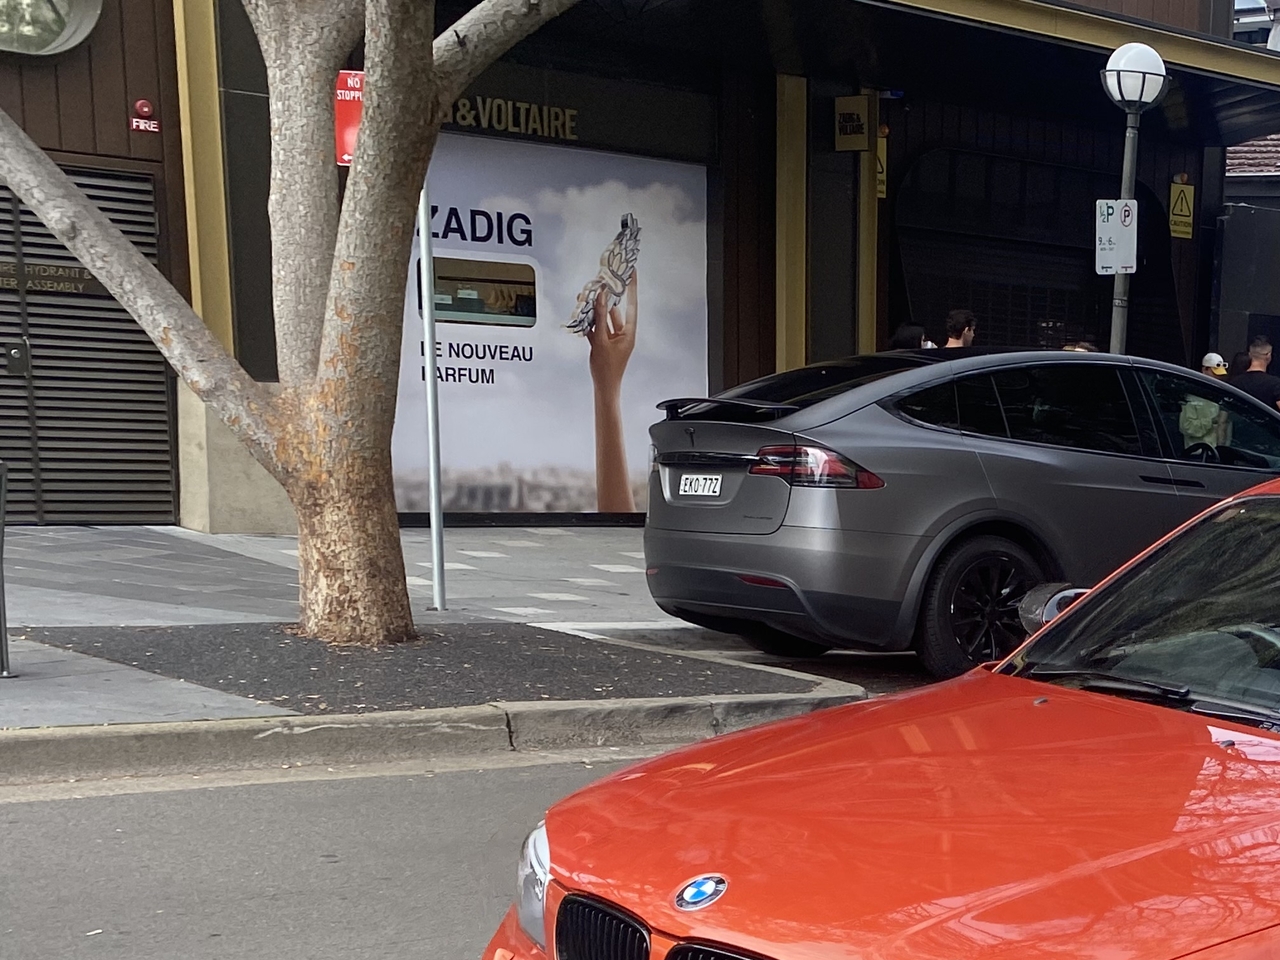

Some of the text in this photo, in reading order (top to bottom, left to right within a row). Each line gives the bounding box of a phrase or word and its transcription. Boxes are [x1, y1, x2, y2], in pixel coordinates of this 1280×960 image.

[347, 77, 361, 88] NO
[336, 89, 363, 101] STOPPI
[443, 96, 578, 140] &VOLTAIRE
[132, 118, 159, 132] FIRE
[24, 265, 79, 278] HYDRANT
[26, 280, 84, 293] ASSEMBLY
[448, 342, 533, 362] NOUVEAU
